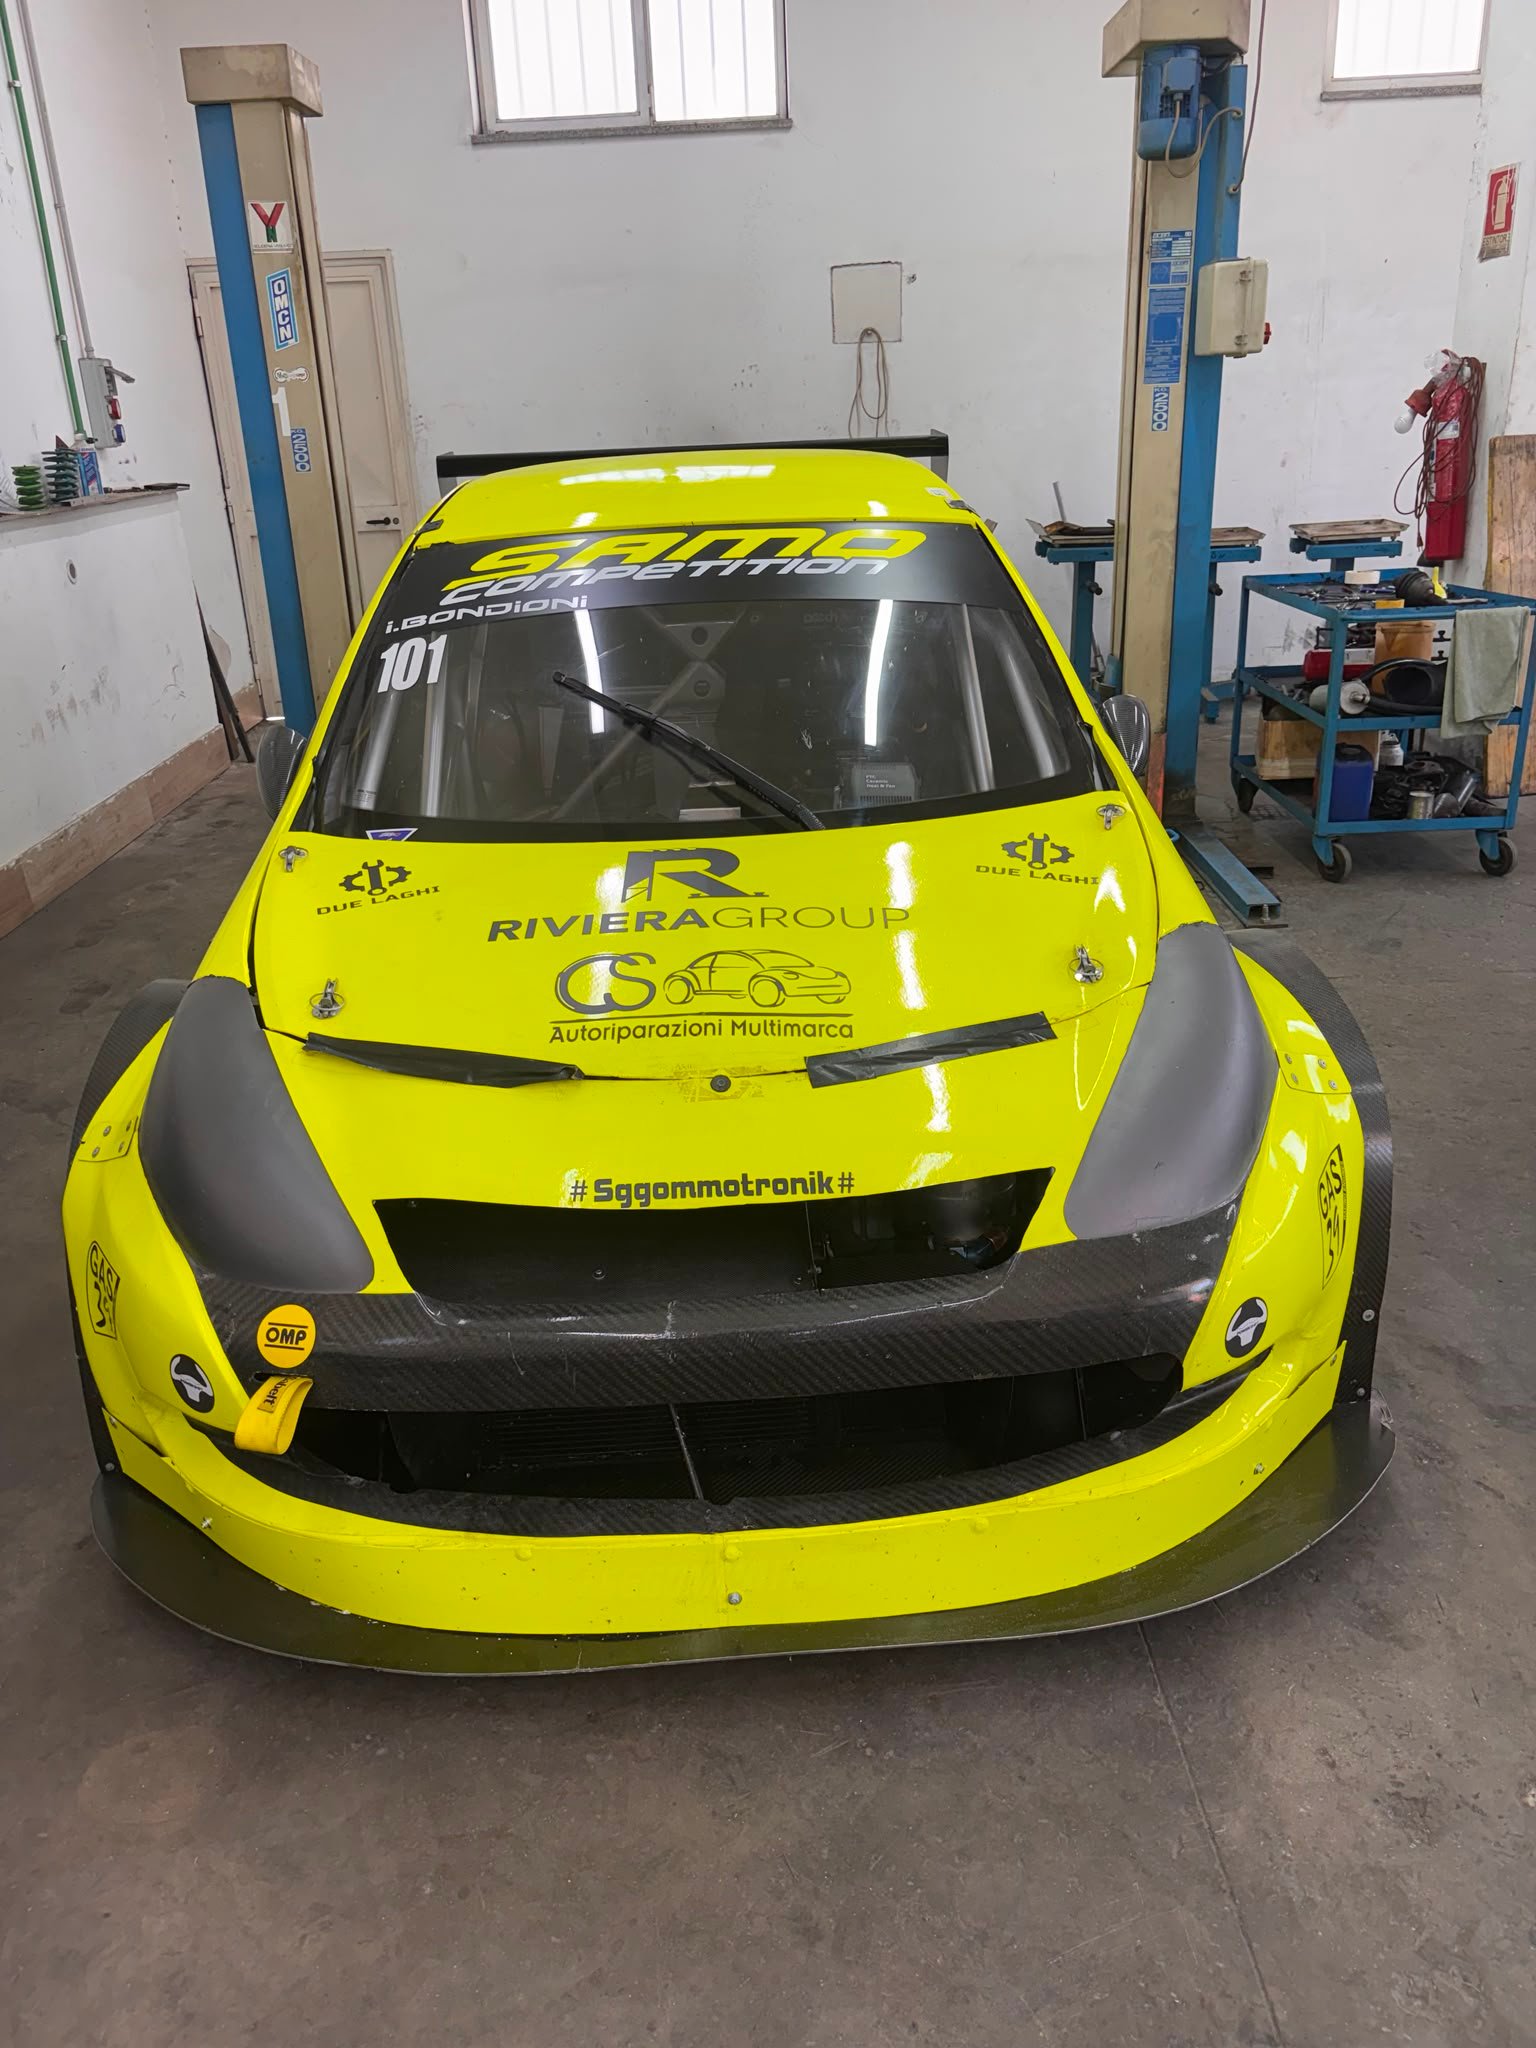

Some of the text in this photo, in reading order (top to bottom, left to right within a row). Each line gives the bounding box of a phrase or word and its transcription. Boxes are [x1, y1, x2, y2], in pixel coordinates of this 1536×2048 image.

[273, 279, 292, 342] OMCN
[272, 387, 291, 437] 1
[1152, 392, 1168, 431] 2500
[292, 433, 311, 472] 2500
[442, 528, 927, 591] SAMO
[377, 634, 448, 693] 101
[976, 865, 1099, 885] DUE LAGHI
[317, 886, 440, 915] DUE LAGHI
[487, 906, 909, 942] RIVIERAGROUP
[555, 951, 657, 1014] CS
[549, 1018, 854, 1044] Autoriparazioni Multimarca
[1319, 1158, 1342, 1220] GAS
[90, 1244, 113, 1302] GAS
[266, 1327, 307, 1345] OMP
